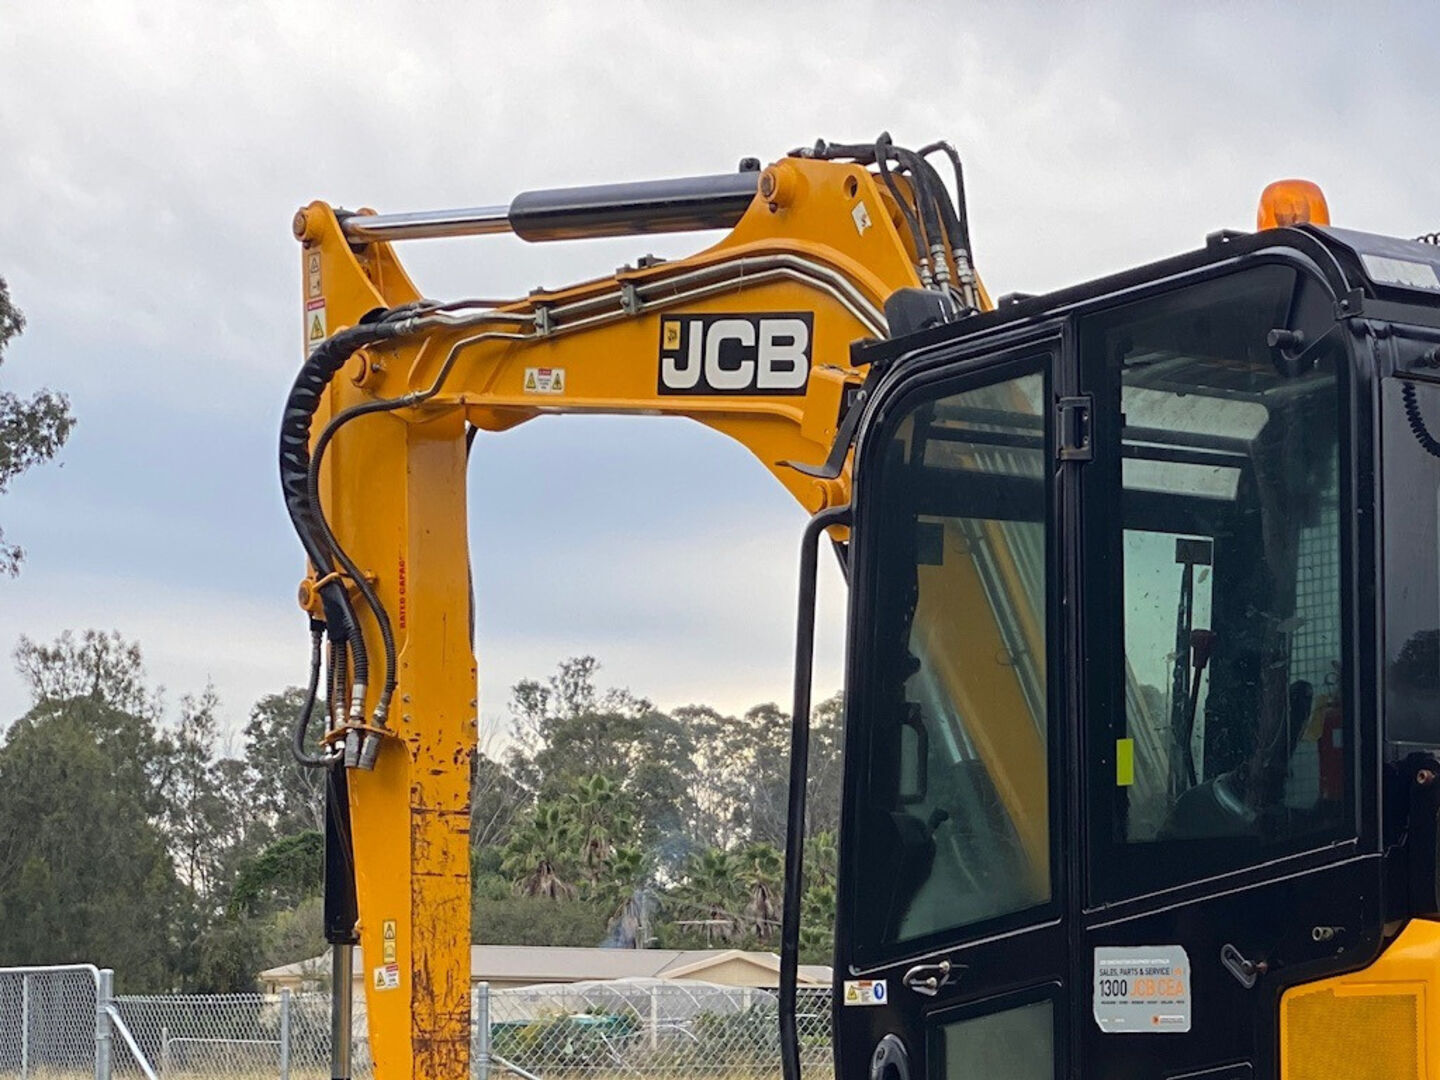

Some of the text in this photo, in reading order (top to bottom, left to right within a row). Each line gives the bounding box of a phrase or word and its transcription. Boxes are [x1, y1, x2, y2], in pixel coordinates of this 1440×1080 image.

[662, 318, 809, 390] JCB
[1119, 967, 1139, 976] PARTS
[1145, 966, 1170, 976] SERVICE
[1099, 979, 1128, 997] 1300
[1130, 978, 1157, 997] JCB
